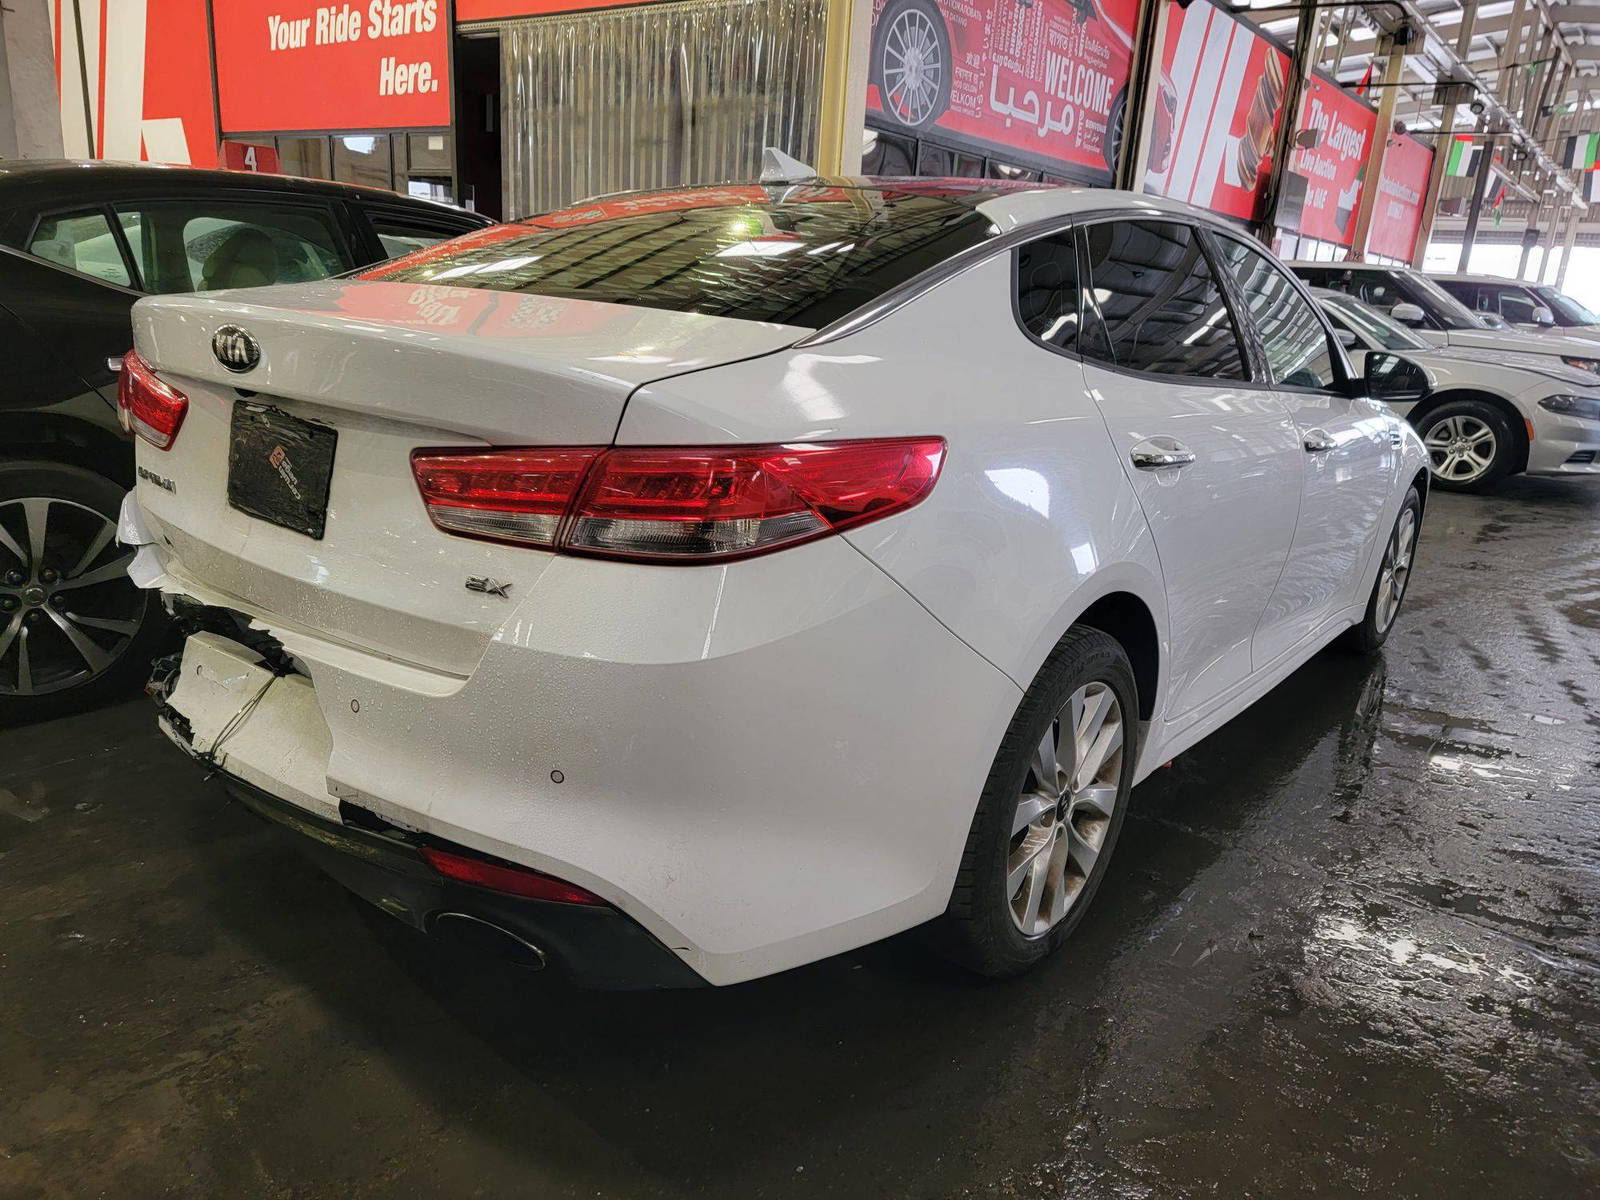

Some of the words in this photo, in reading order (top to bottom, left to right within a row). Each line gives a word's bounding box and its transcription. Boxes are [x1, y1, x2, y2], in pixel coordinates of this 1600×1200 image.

[267, 14, 311, 51] Your
[315, 4, 362, 46] Ride
[367, 0, 438, 40] Starts
[379, 56, 439, 96] Here.
[989, 63, 1075, 138] مرحبا
[1044, 50, 1114, 116] WELCOME
[1308, 98, 1329, 149] The
[1327, 110, 1367, 161] Largest
[244, 146, 257, 172] 4
[216, 333, 249, 364] KIA
